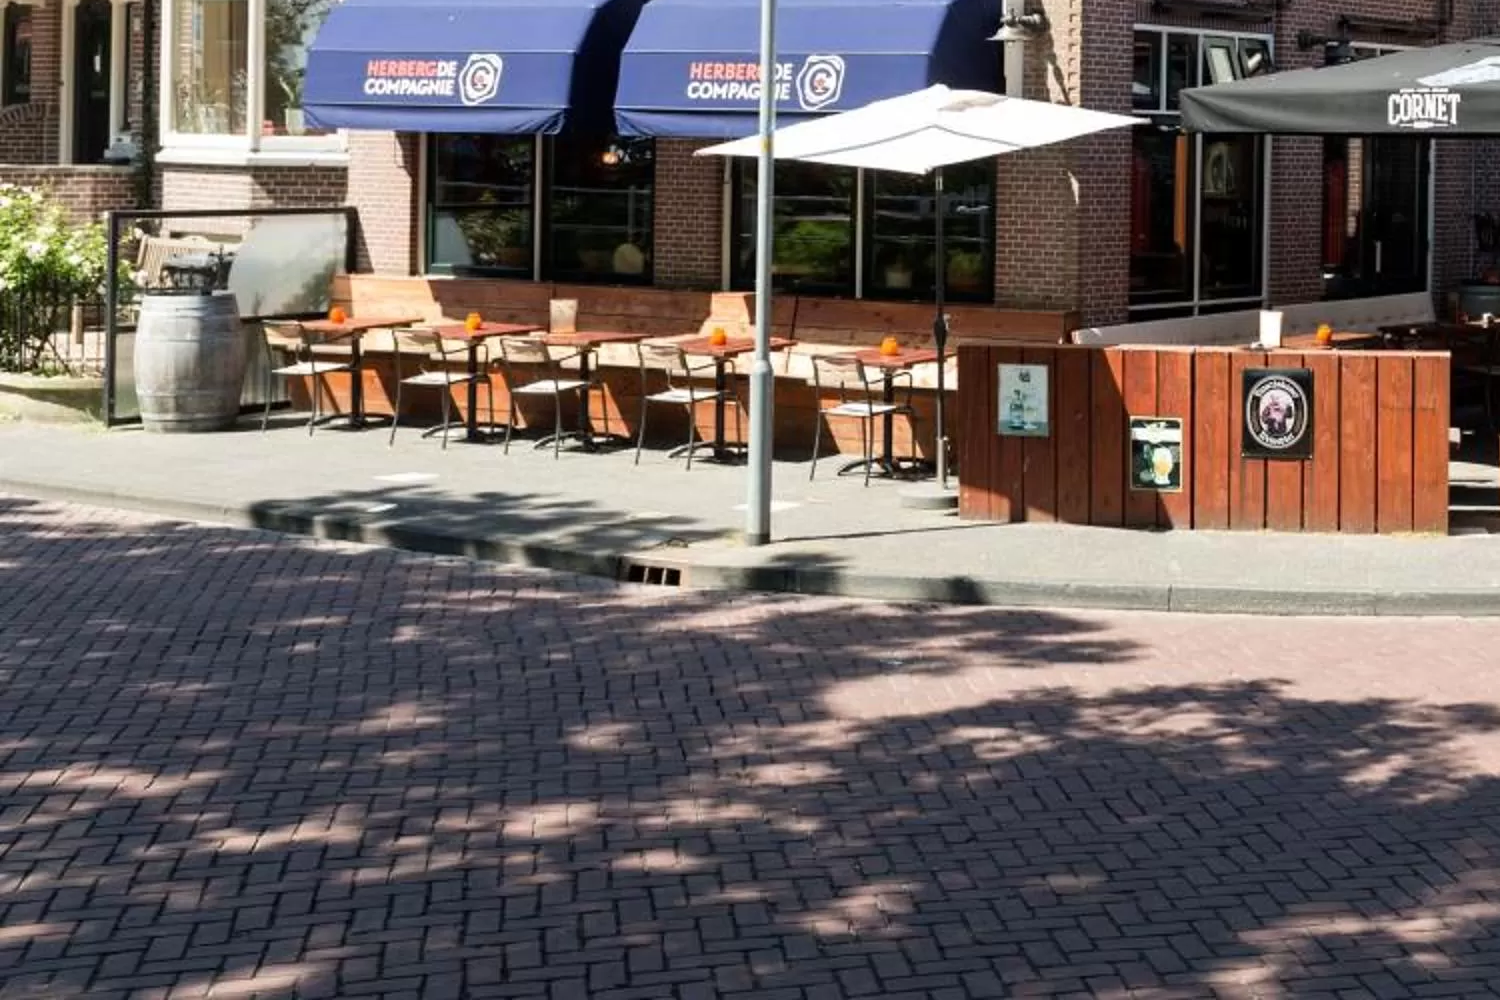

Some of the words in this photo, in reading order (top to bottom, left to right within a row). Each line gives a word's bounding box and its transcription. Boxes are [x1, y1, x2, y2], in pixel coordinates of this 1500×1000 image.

[363, 78, 455, 96] COMPAGNIE
[686, 81, 791, 100] COMPAGIE
[1386, 92, 1461, 126] CORNET
